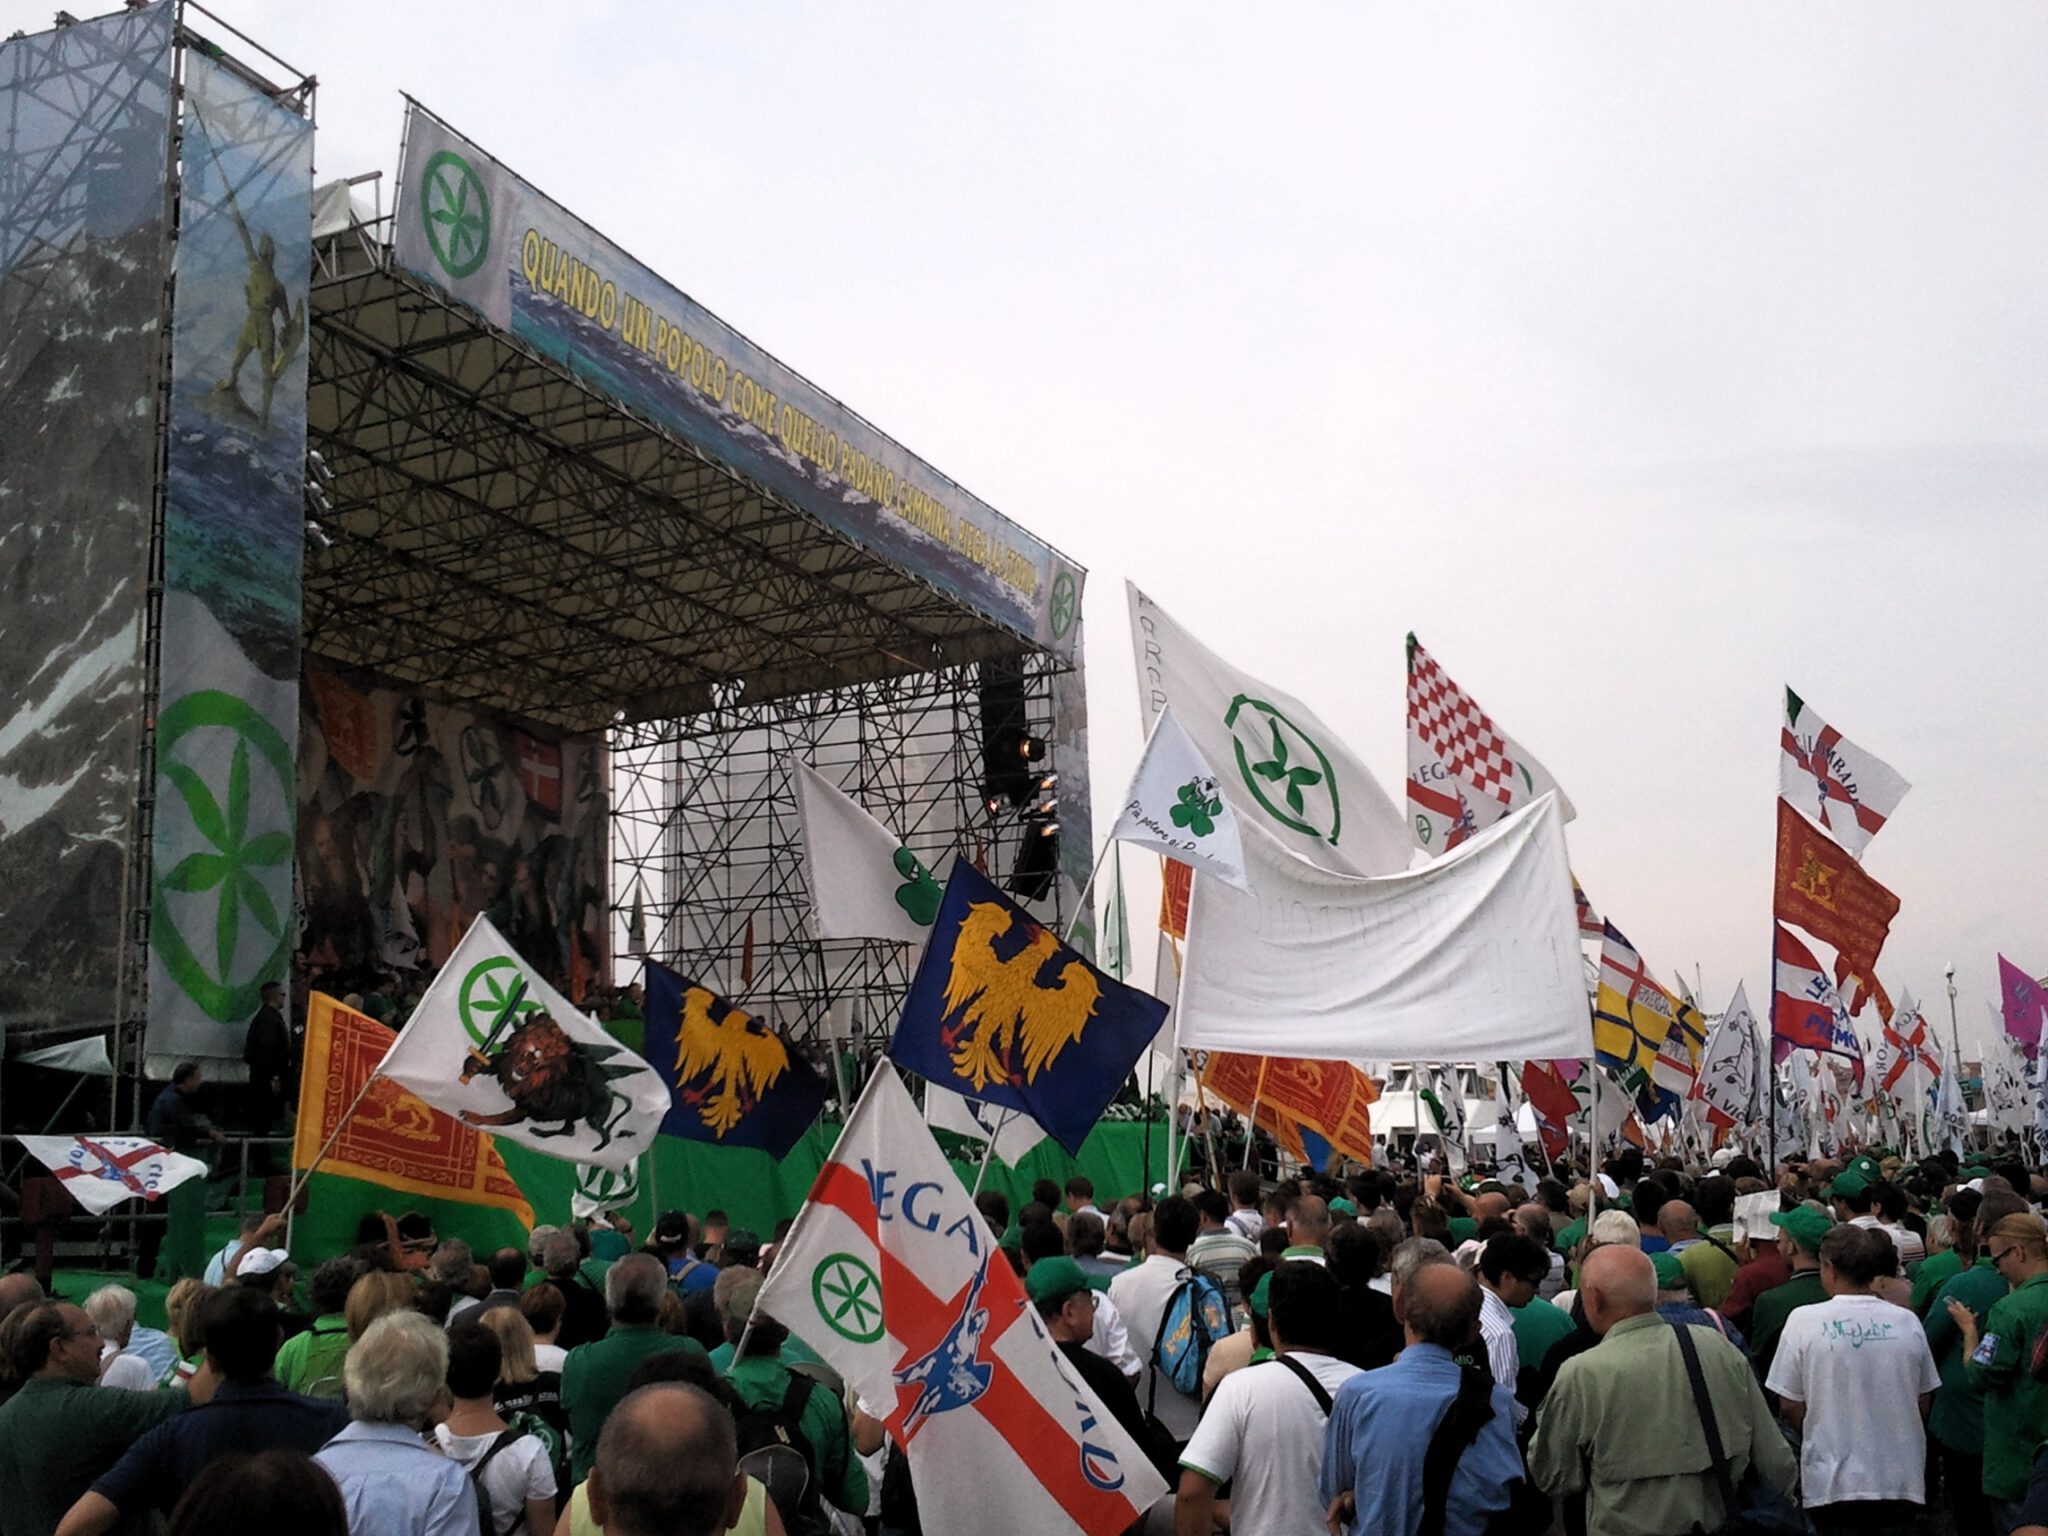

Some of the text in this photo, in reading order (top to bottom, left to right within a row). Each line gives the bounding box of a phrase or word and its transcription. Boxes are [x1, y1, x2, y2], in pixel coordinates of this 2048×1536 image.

[521, 227, 618, 332] QUANDO
[620, 291, 655, 354] UN
[654, 314, 729, 403] POPOLO
[731, 370, 778, 436] COME
[780, 403, 839, 474] QUELLO
[839, 441, 895, 509] PADANO
[896, 478, 952, 549] CAMMINA
[1136, 816, 1169, 841] potere
